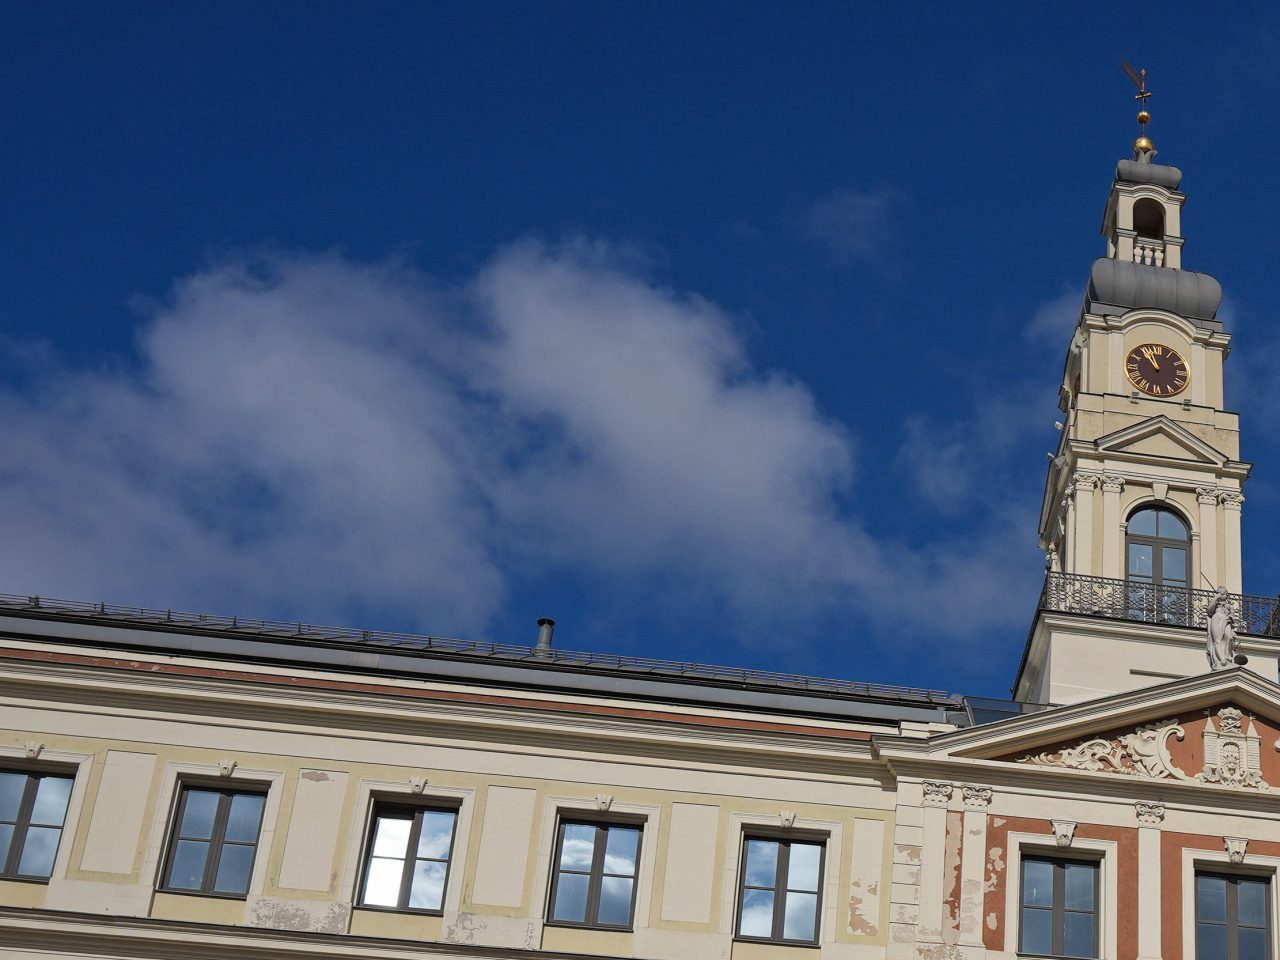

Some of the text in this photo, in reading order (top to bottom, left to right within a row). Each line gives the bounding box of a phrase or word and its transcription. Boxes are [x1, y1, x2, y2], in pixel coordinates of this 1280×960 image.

[1153, 346, 1162, 355] XII
[1139, 380, 1149, 390] VII
[1153, 384, 1161, 393] VI
[1166, 384, 1174, 392] V
